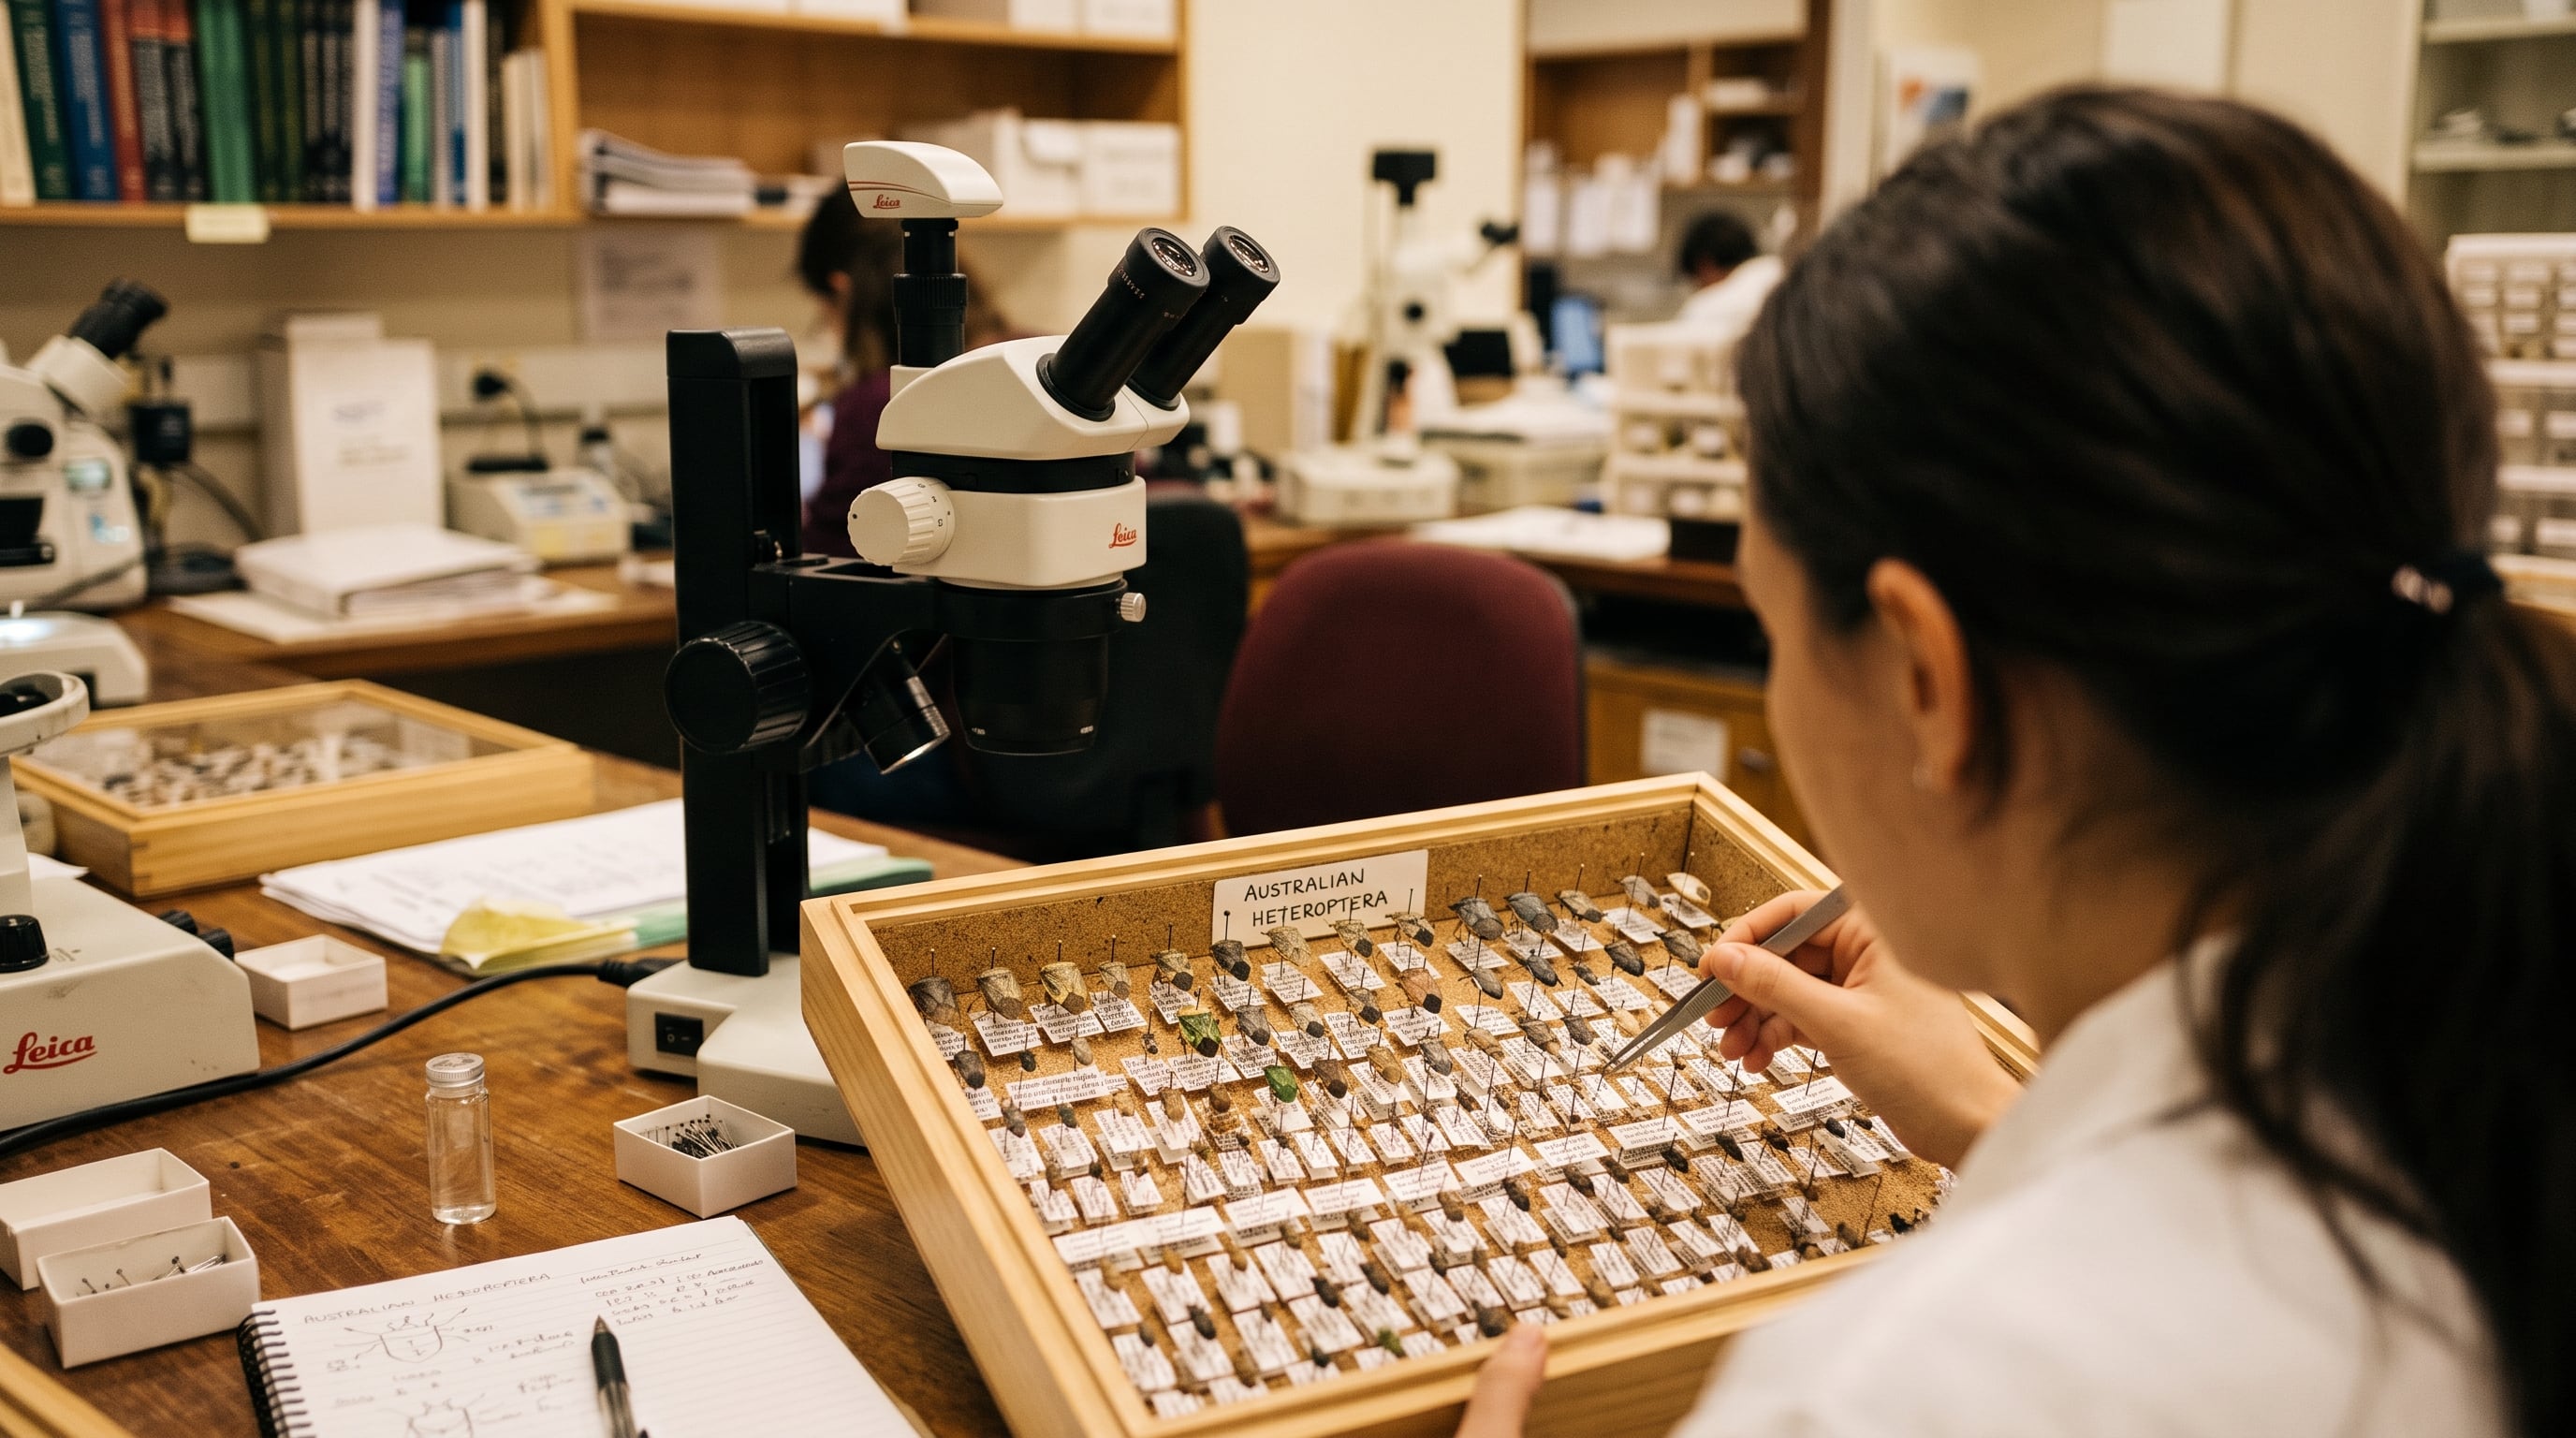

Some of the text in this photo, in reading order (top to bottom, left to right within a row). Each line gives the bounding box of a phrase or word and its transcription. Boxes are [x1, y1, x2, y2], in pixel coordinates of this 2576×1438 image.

[1108, 522, 1138, 549] Leica
[1244, 868, 1365, 902] AUSTRALIAN
[1252, 890, 1388, 927] HETEROPTERA
[3, 1032, 97, 1075] Leica
